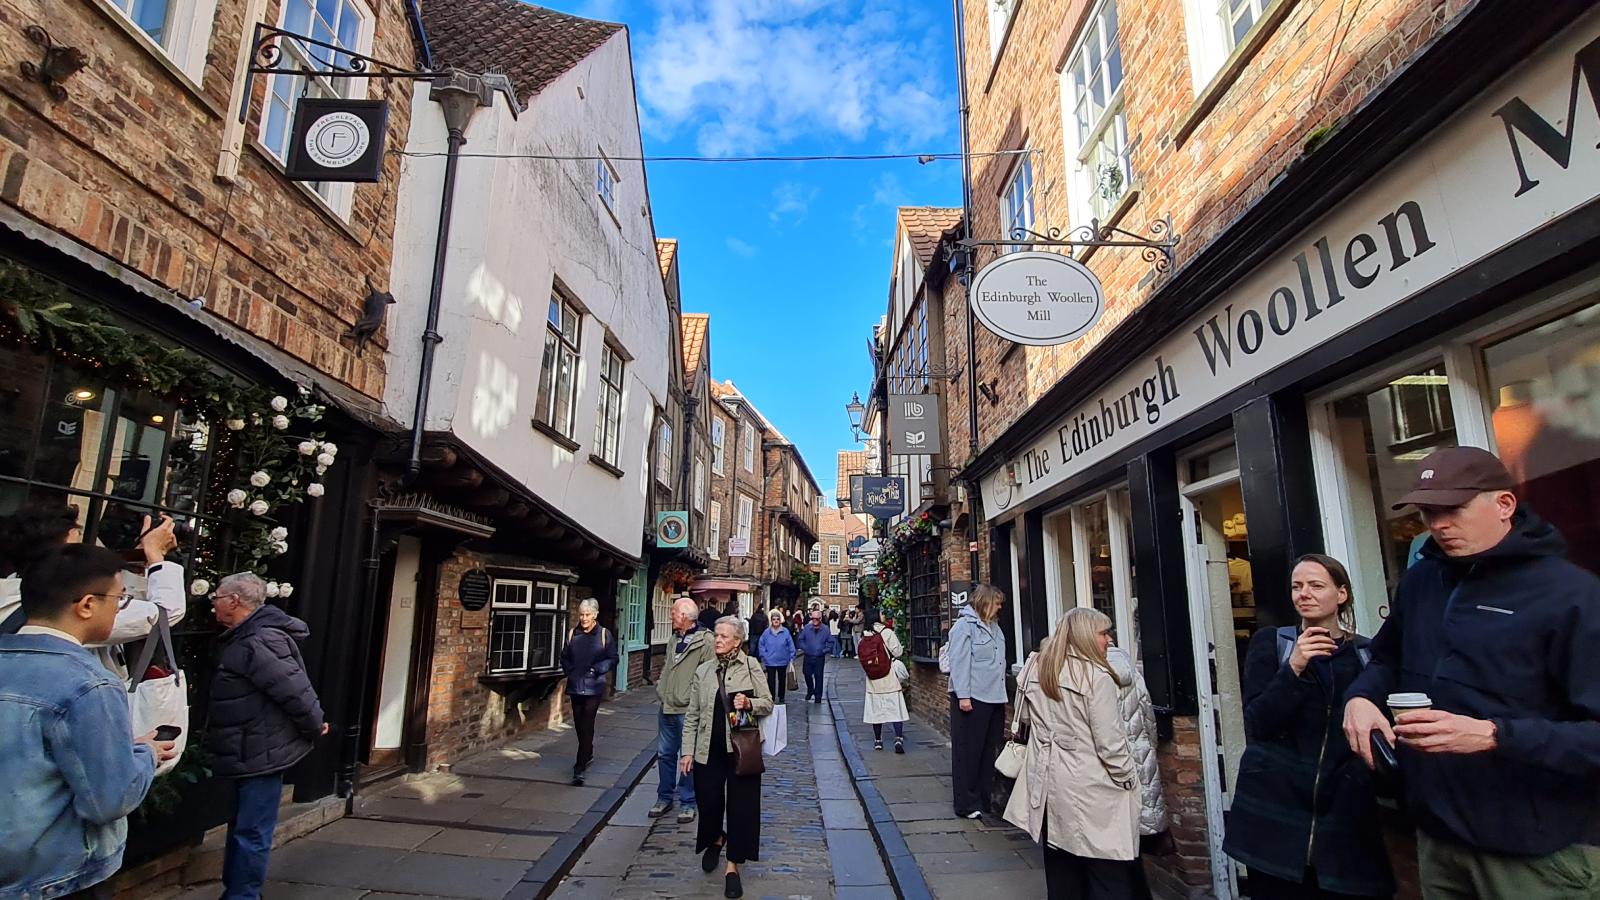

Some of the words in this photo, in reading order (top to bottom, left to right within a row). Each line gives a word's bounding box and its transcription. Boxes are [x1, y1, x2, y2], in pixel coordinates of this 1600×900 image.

[317, 115, 364, 130] FRECKLEFACE
[331, 132, 347, 148] F
[314, 153, 352, 165] SHAMBLES
[353, 142, 365, 157] YORK
[1025, 275, 1048, 287] The
[981, 291, 1042, 306] Edinburgh
[1047, 291, 1094, 304] Woollen
[1026, 310, 1051, 321] Mill
[1023, 448, 1051, 485] The
[1057, 355, 1181, 465] Edinburgh
[1192, 200, 1437, 377] Woollen
